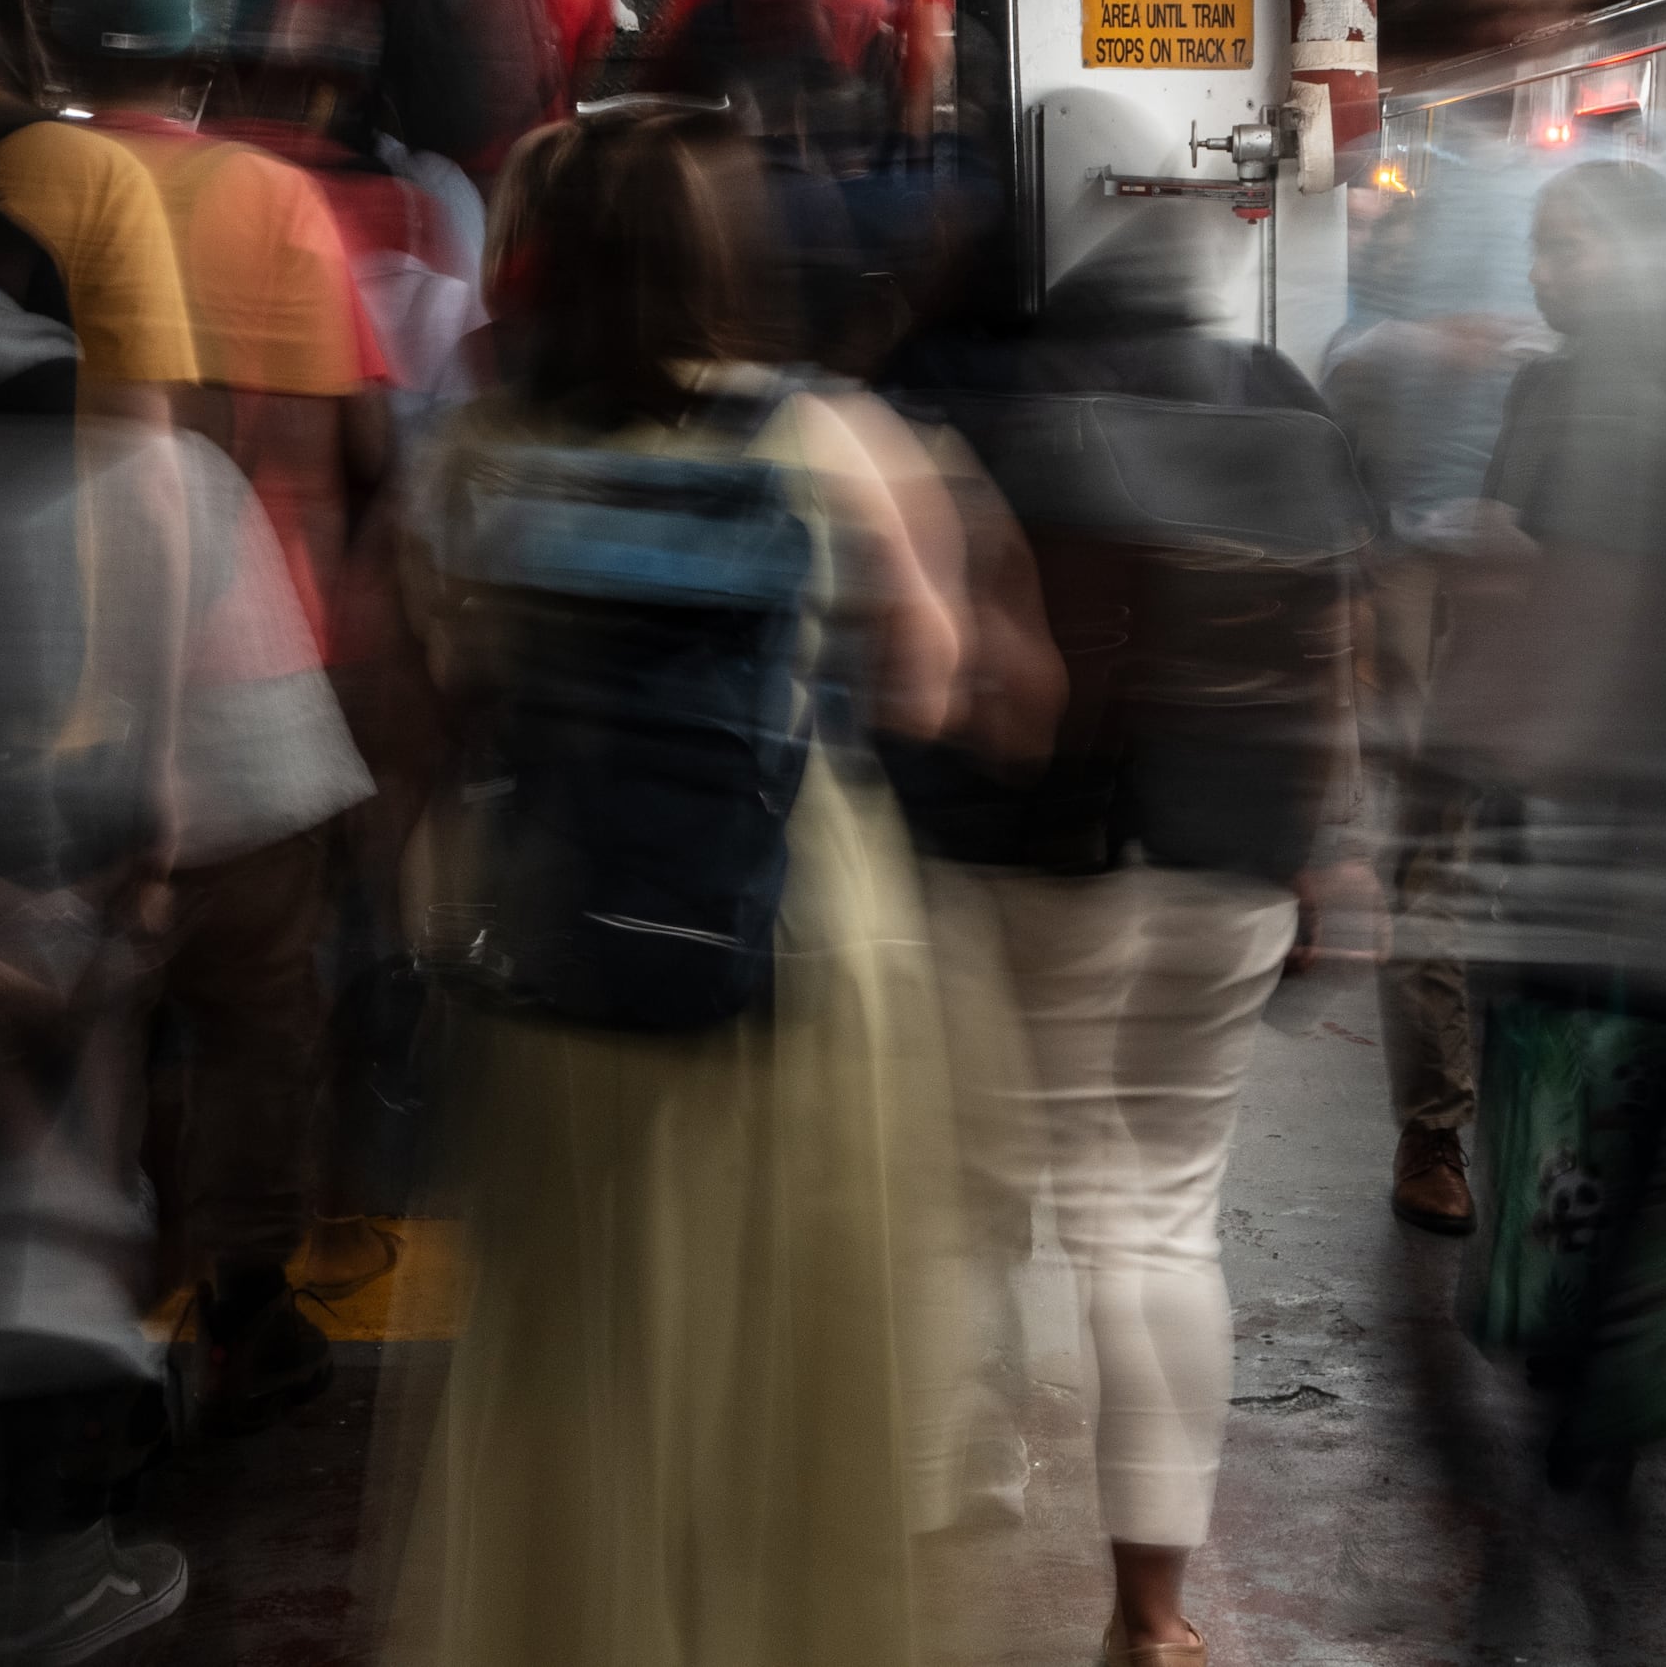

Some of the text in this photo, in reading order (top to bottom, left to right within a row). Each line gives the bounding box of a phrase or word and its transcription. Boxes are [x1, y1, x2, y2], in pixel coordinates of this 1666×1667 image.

[1101, 3, 1235, 28] AREA UNTIL TRAIN
[1096, 37, 1247, 63] STOPS ON TRACK 17
